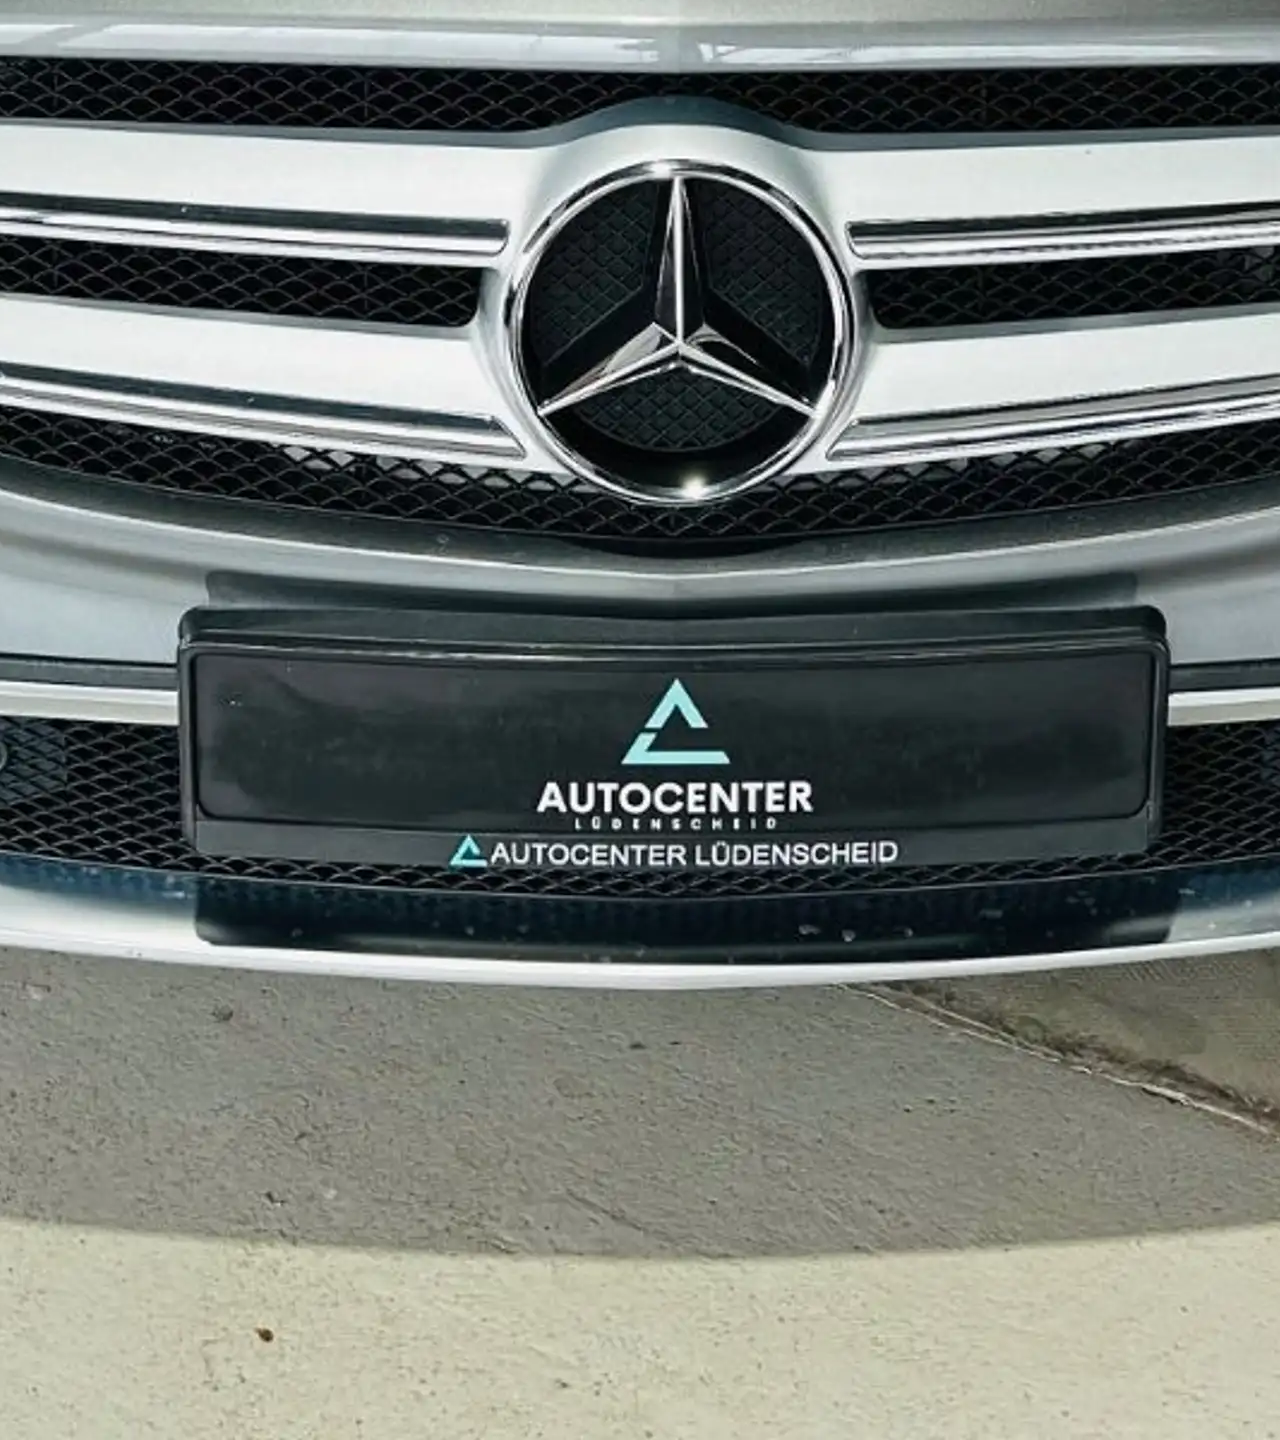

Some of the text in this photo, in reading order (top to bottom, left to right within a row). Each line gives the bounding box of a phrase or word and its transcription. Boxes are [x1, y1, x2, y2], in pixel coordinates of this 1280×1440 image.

[536, 781, 814, 814] AUTOCENTER
[574, 817, 778, 831] LÜDENSCHEID
[490, 840, 899, 867] AUTOCENTER LÜDENSCHEID
